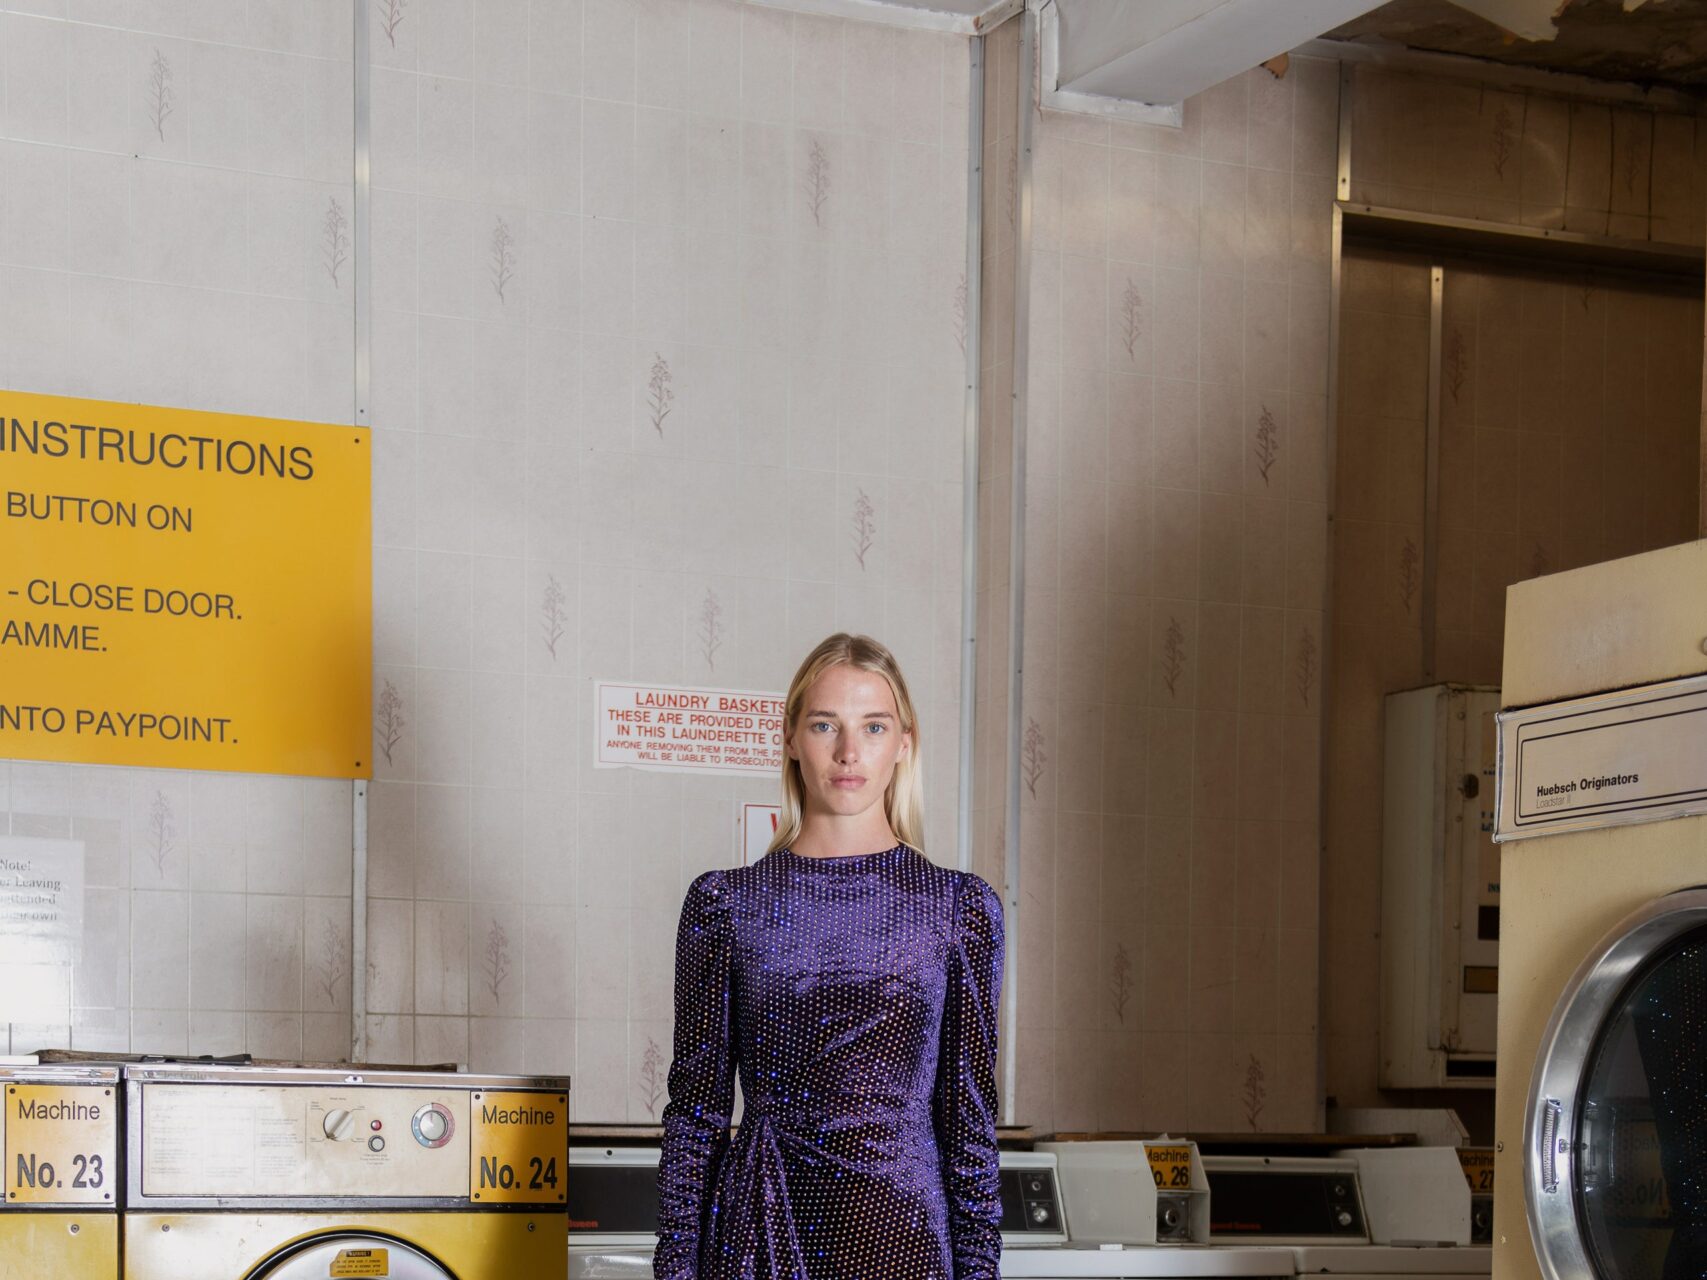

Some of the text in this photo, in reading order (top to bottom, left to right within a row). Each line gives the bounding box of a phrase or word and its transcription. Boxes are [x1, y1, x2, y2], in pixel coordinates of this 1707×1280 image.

[0, 417, 314, 480] INSTRUCTIONS
[7, 491, 192, 532] BUTTON ON
[27, 579, 134, 611] CLOSE
[144, 589, 242, 620] DOOR.
[636, 692, 785, 714] LAUNDRY BASKETS
[76, 710, 238, 744] PAYPOINT.
[608, 709, 651, 723] THESE
[657, 713, 683, 725] ARE
[690, 714, 753, 729] PROVIDED
[617, 725, 630, 736] IN
[636, 725, 666, 738] THIS
[672, 728, 766, 744] LAUNDERETTE
[606, 740, 642, 750] ANYONE
[646, 742, 693, 752] REMOVING
[697, 744, 720, 754] THEM
[724, 746, 748, 756] FROM
[752, 748, 768, 757] THE
[637, 751, 657, 760] WILL
[661, 752, 672, 761] BE
[677, 753, 705, 763] LIABLE
[710, 755, 721, 764] TO
[1536, 773, 1639, 797] Huebsch Originators
[15, 876, 61, 892] Leaving
[18, 1098, 101, 1120] Machine
[482, 1105, 555, 1125] Machine
[17, 1153, 104, 1188] No. 23
[480, 1156, 557, 1189] No. 24
[1150, 1165, 1189, 1186] o. 26
[1480, 1169, 1495, 1189] 27
